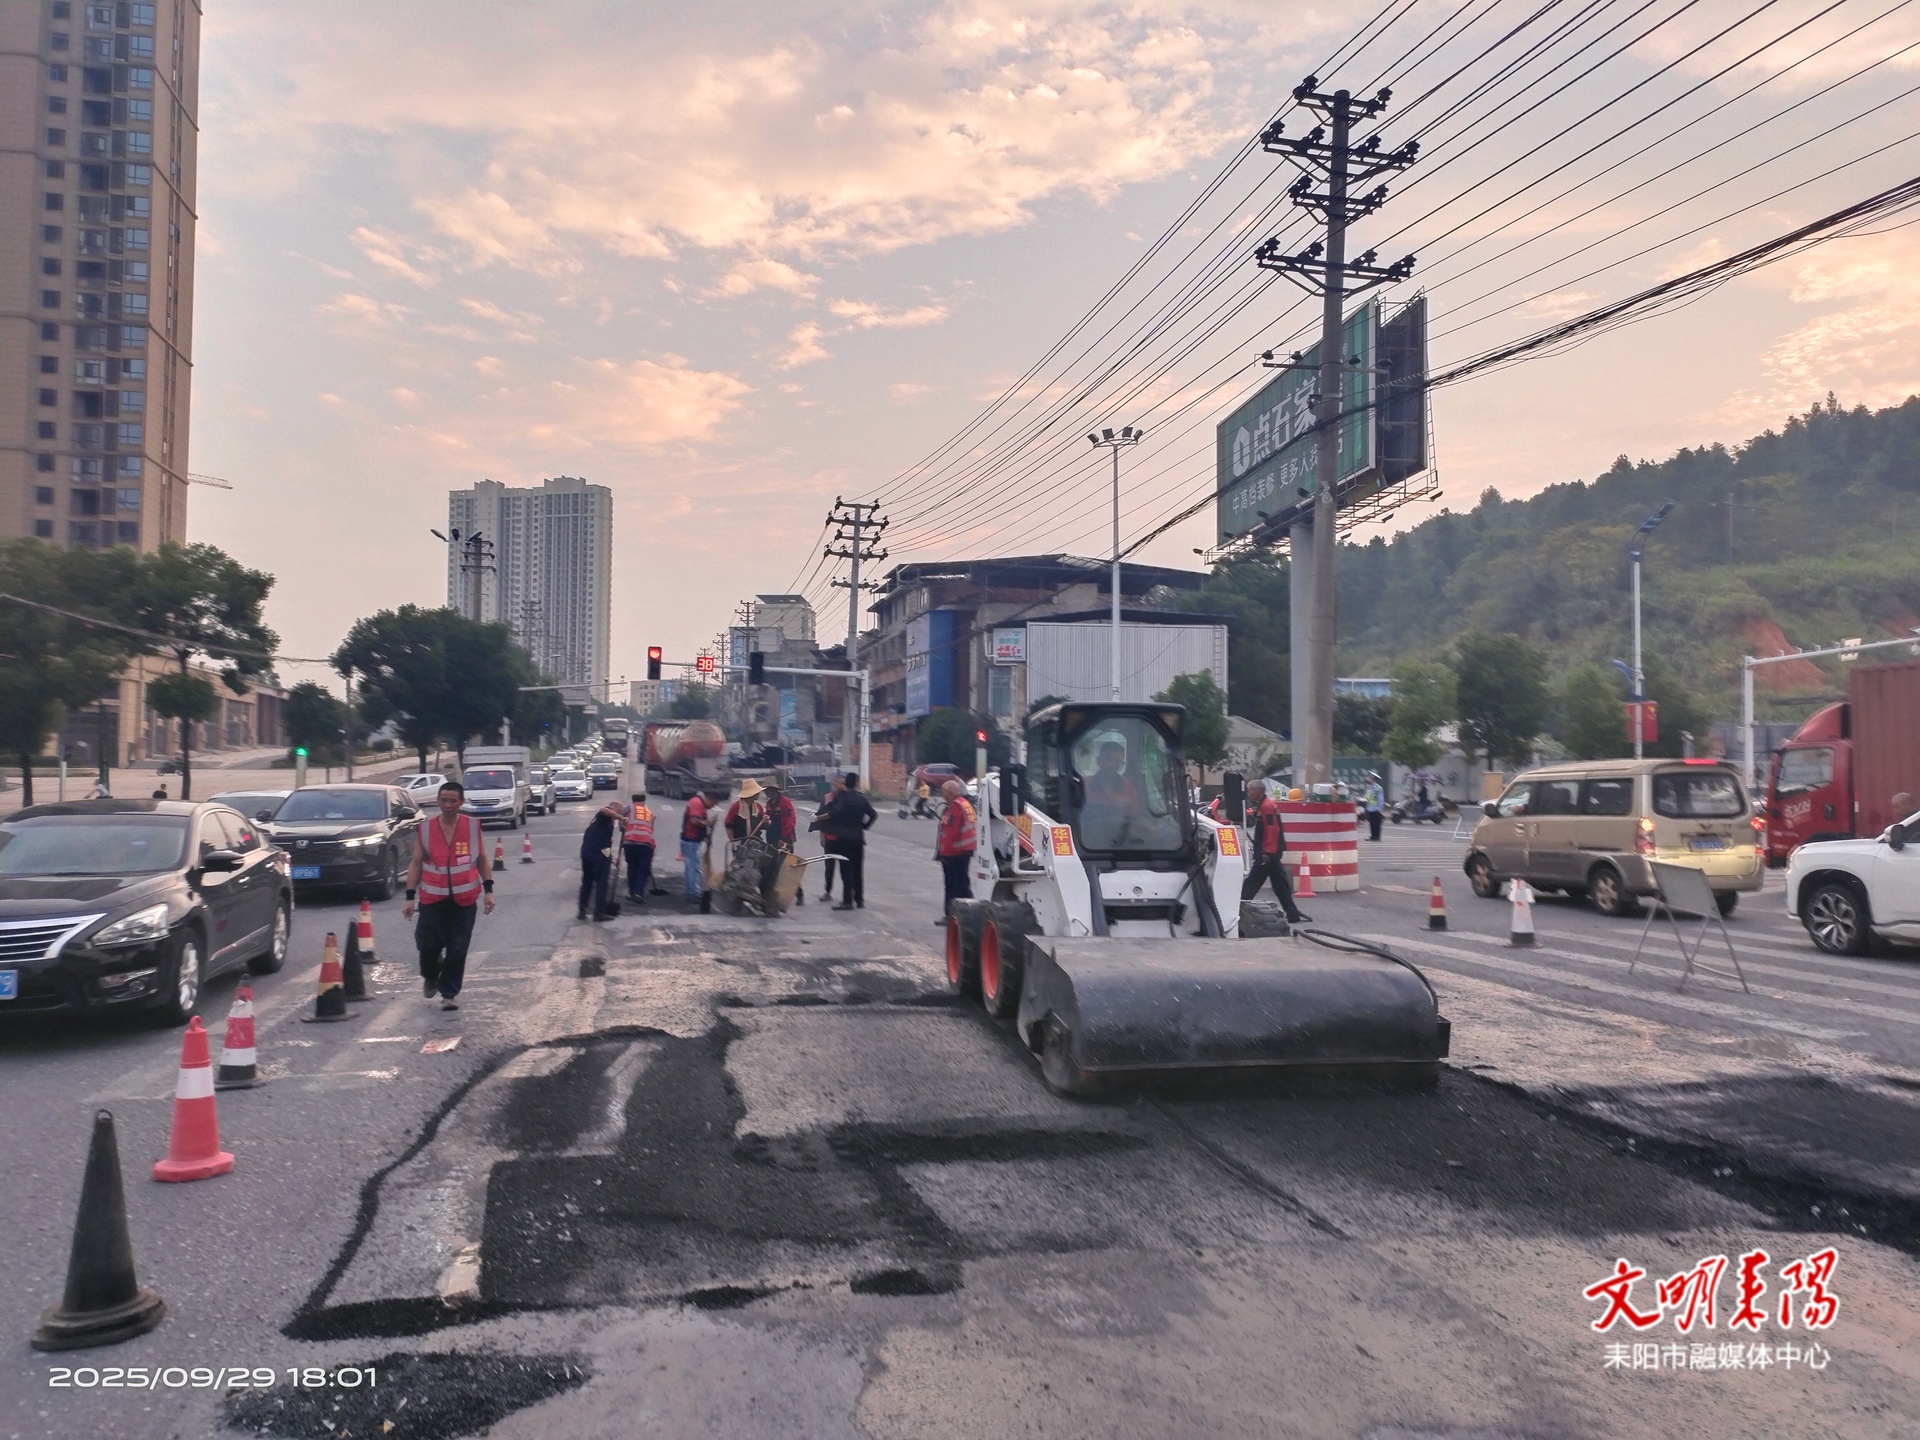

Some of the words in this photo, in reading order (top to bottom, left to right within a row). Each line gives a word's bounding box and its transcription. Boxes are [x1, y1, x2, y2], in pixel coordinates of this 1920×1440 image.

[1252, 358, 1343, 465] 点石家
[1232, 472, 1275, 516] 中高档装修
[698, 658, 713, 671] 38
[1053, 828, 1071, 856] 华通
[1219, 828, 1237, 856] 道路
